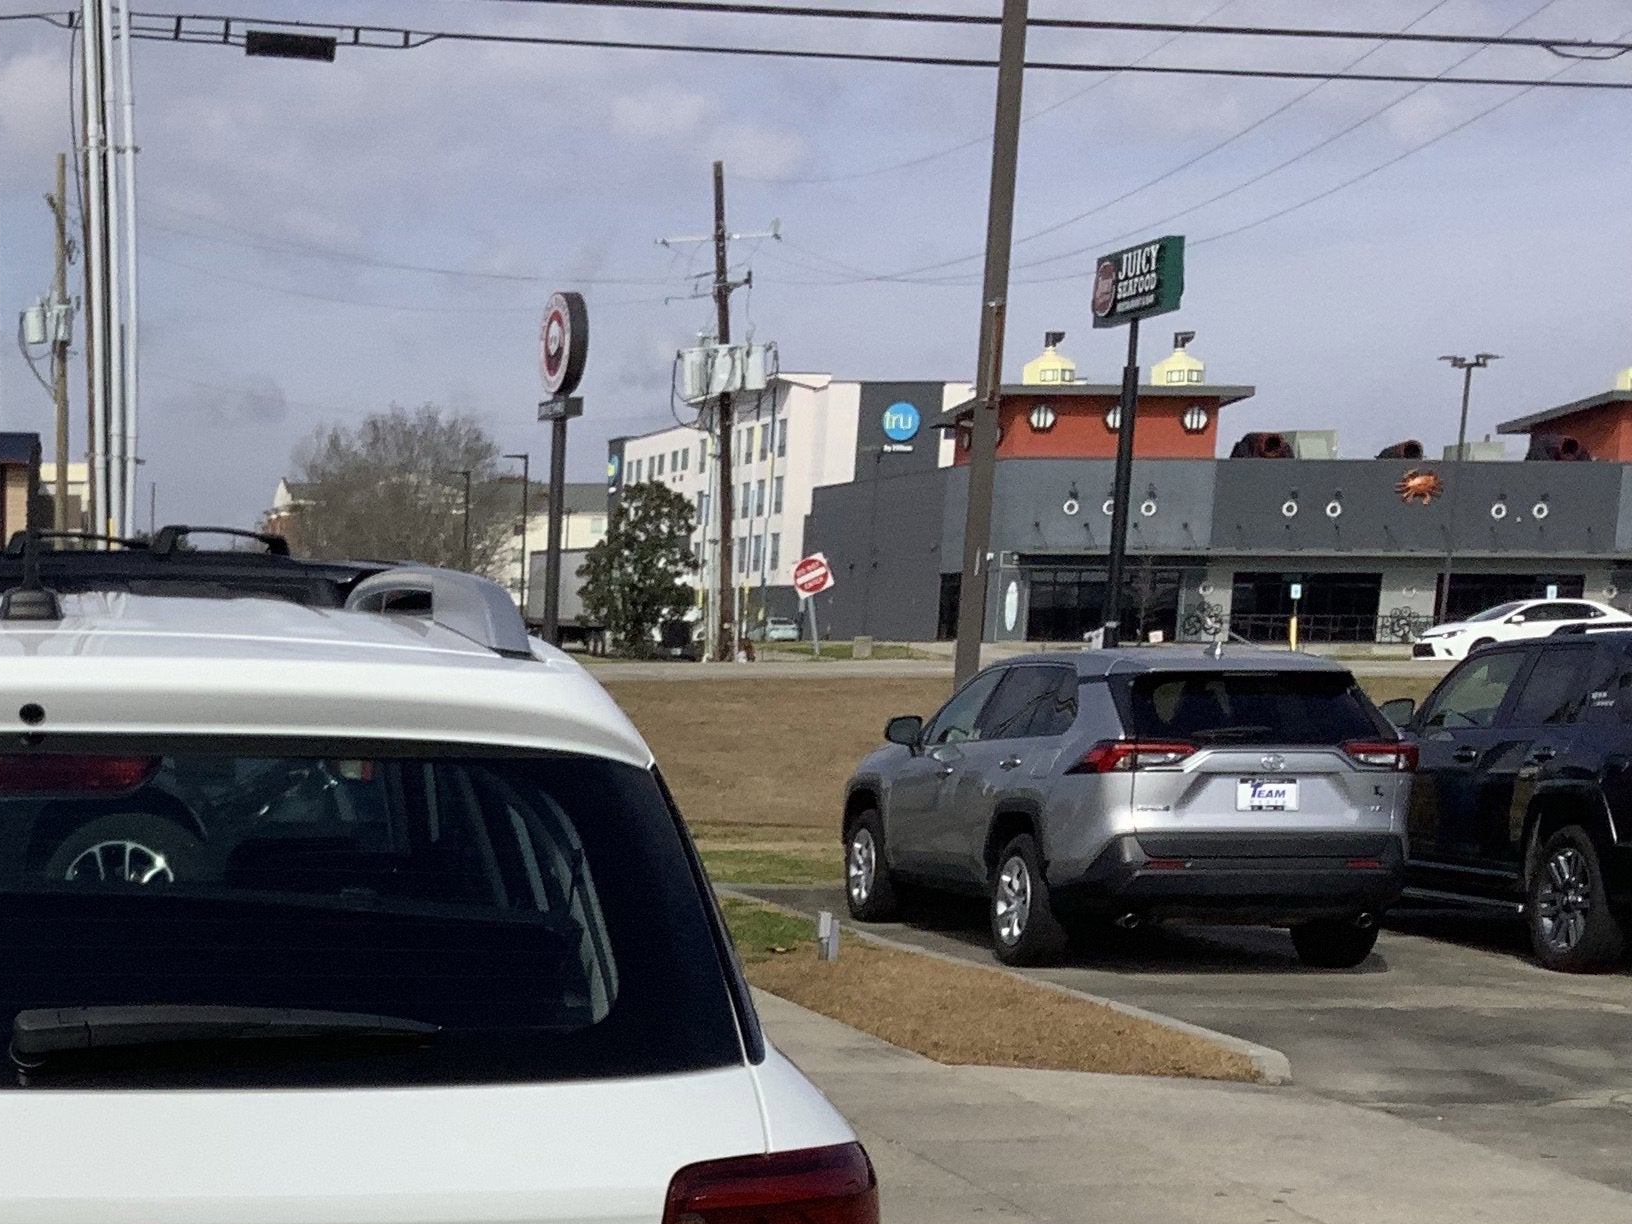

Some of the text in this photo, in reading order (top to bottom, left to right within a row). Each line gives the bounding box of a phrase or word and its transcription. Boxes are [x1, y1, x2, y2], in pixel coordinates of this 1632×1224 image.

[1118, 244, 1160, 280] JUICY
[1116, 271, 1157, 300] SEAFOOD
[884, 411, 913, 430] tru
[1250, 781, 1286, 798] TEAM
